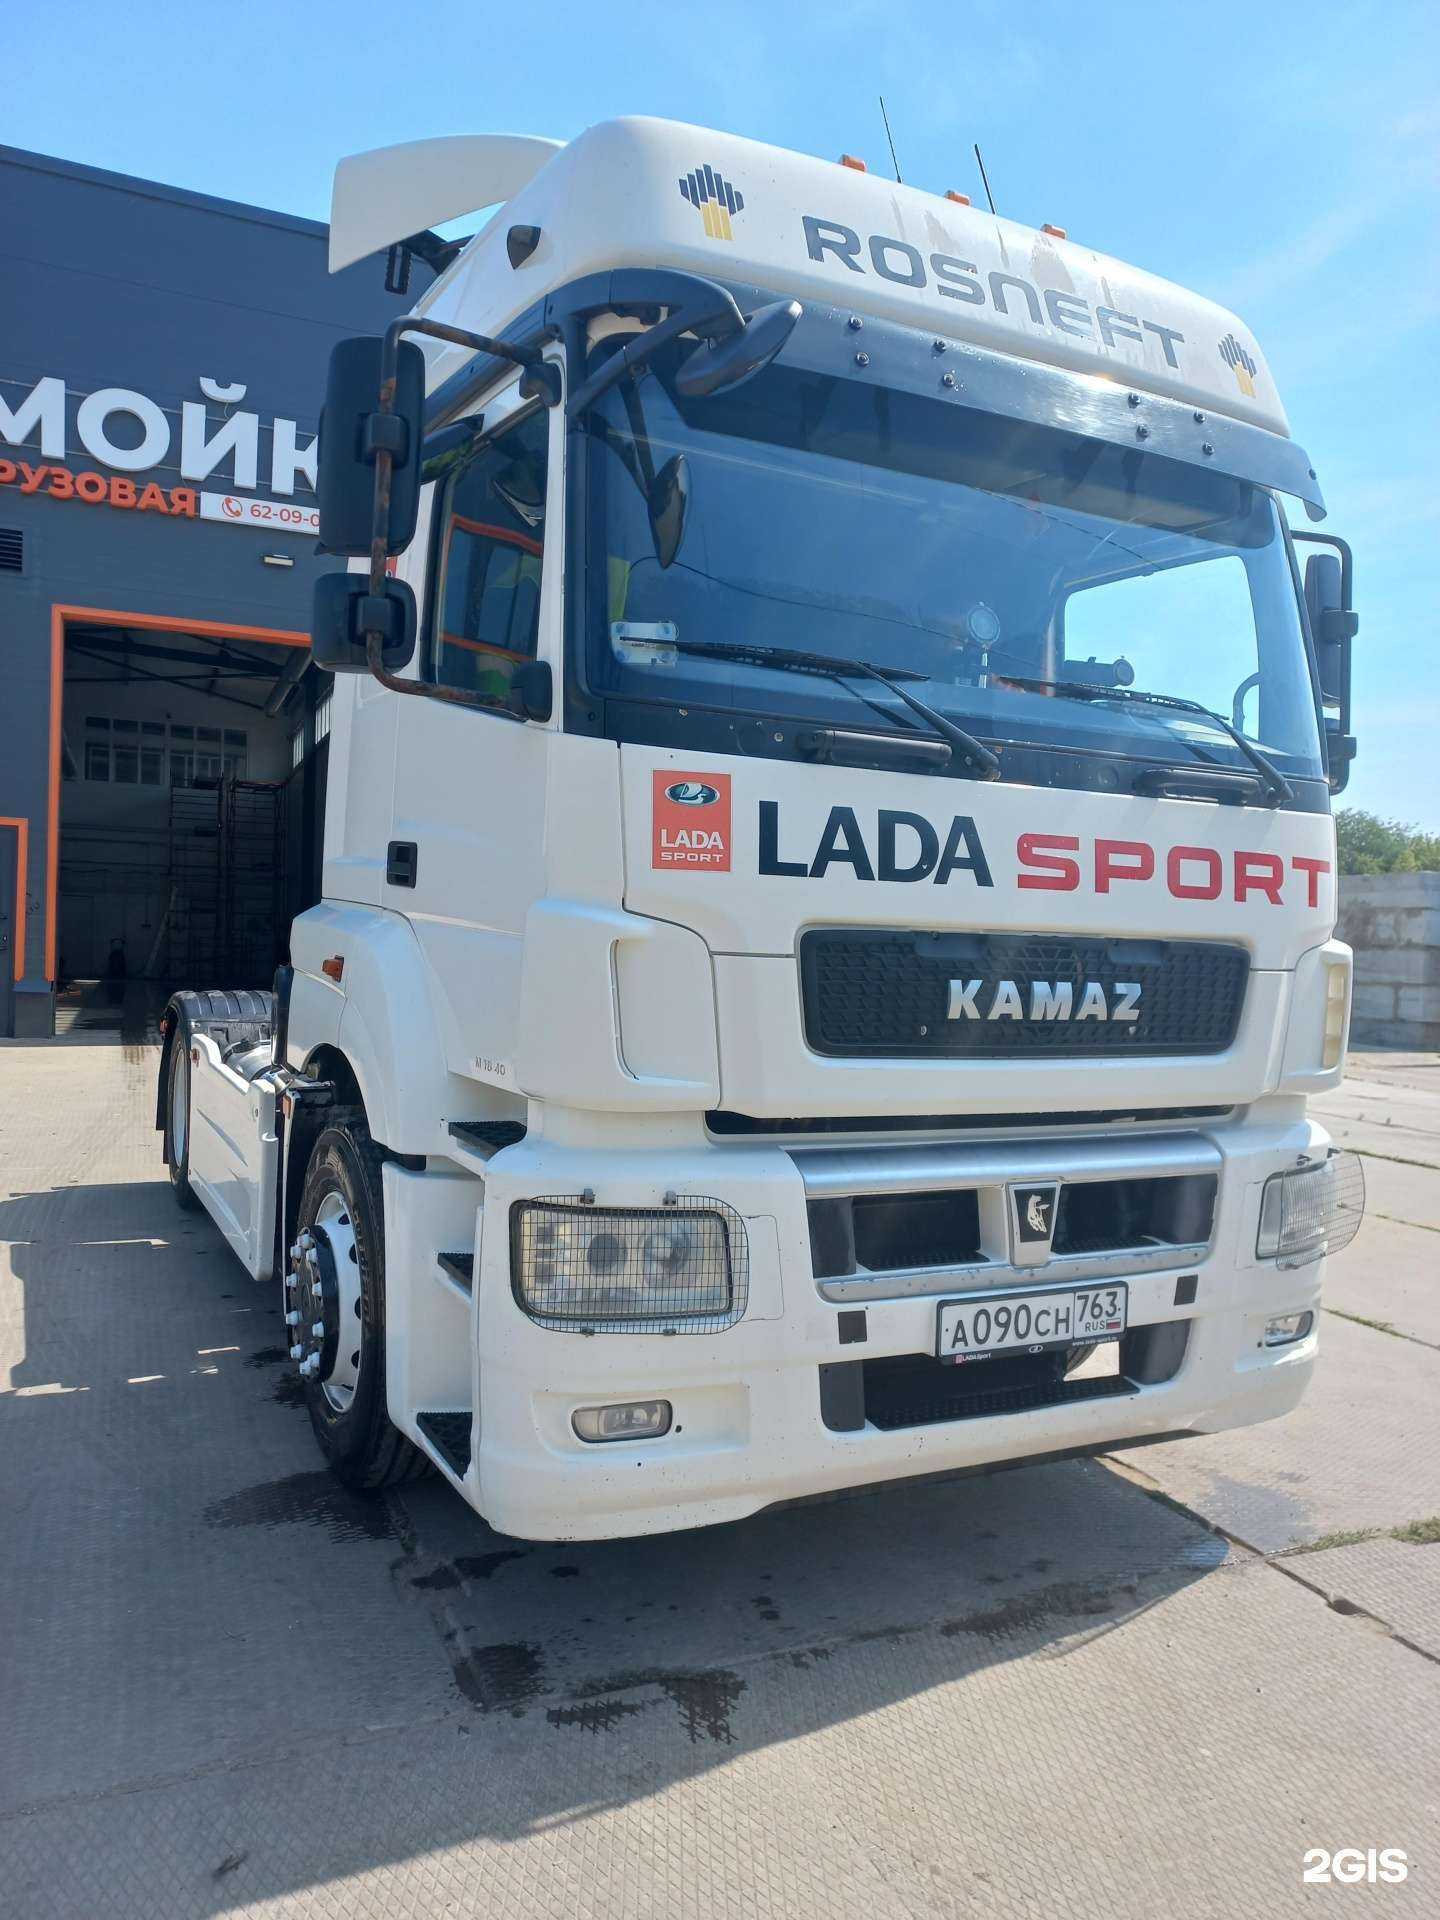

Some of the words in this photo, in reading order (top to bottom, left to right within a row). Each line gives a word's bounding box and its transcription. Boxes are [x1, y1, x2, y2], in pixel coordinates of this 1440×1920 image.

[802, 215, 1184, 368] ROSNEFT
[661, 829, 724, 849] LADA
[758, 800, 994, 887] LADA
[1016, 832, 1331, 908] SPORT
[661, 852, 723, 863] SPORT
[946, 979, 1142, 1021] KAMAZ
[1076, 1291, 1118, 1322] 763
[1084, 1319, 1105, 1333] RUS
